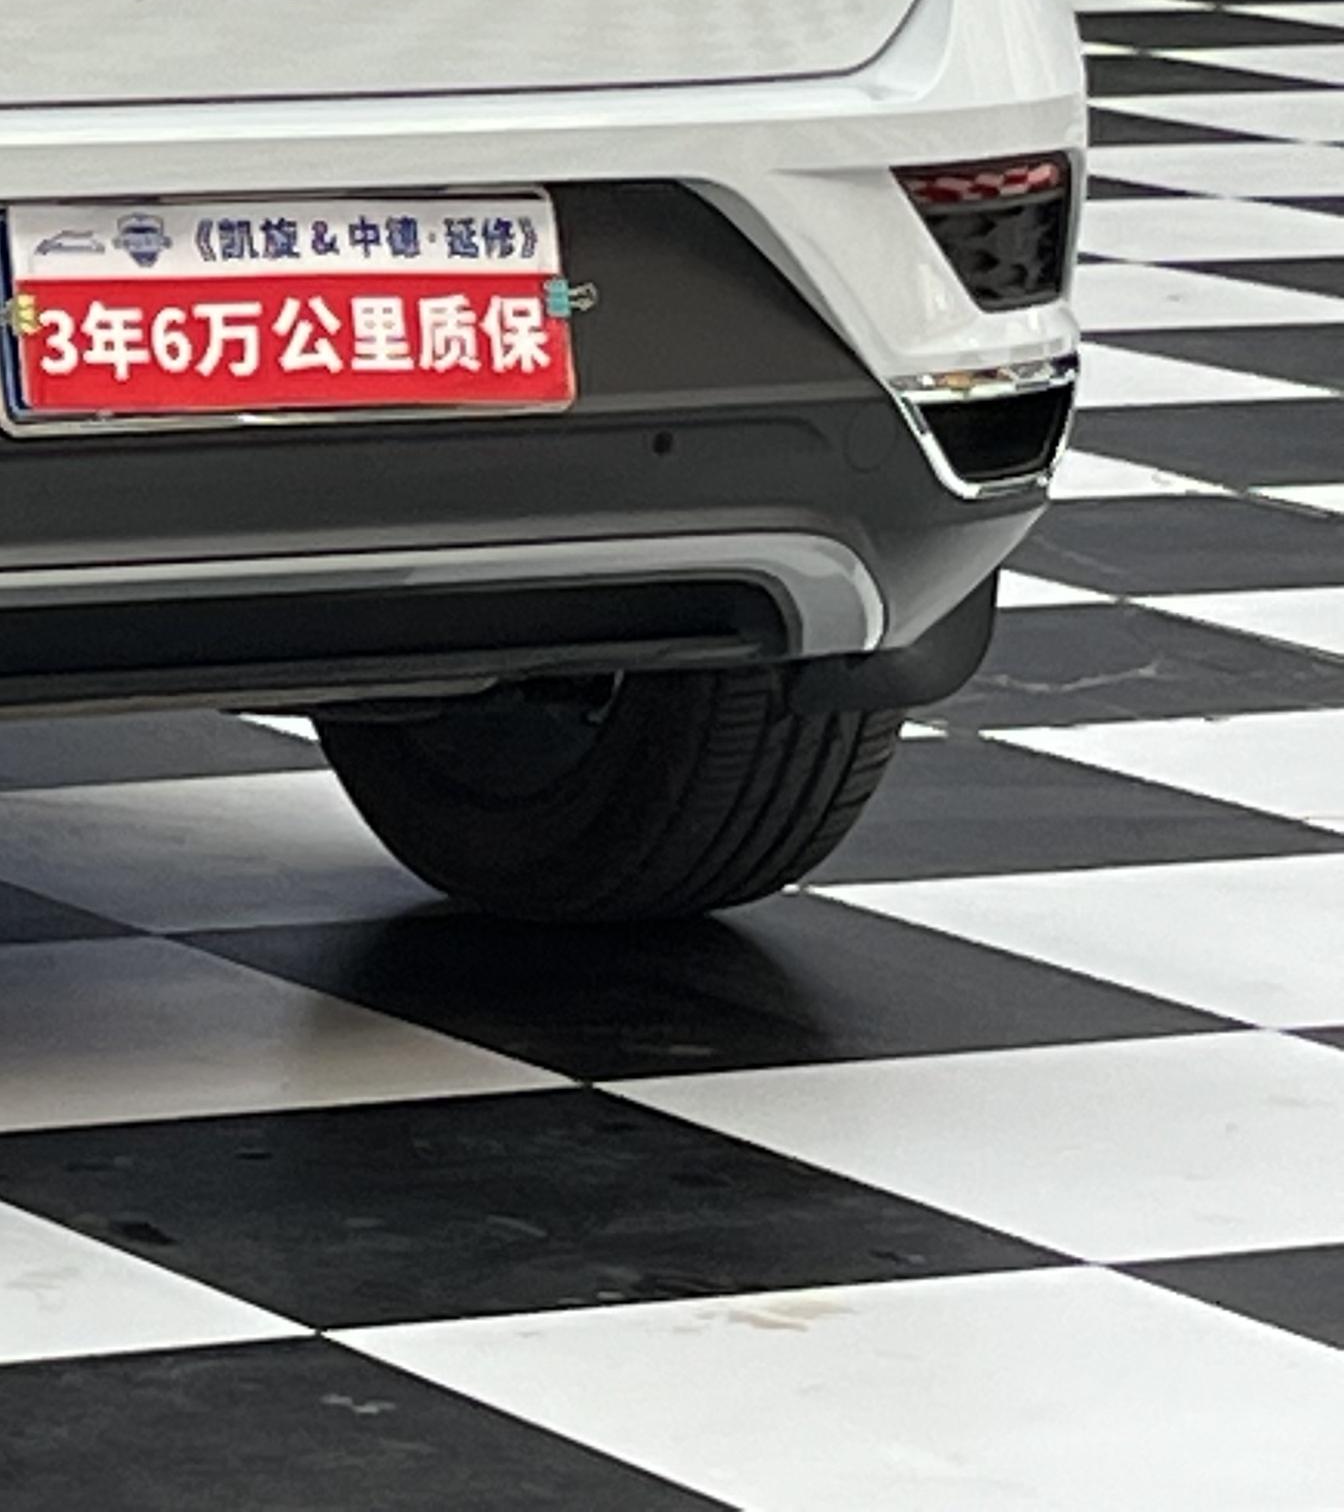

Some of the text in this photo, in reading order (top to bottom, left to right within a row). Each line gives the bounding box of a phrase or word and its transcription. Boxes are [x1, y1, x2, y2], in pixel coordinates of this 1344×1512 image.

[38, 293, 552, 381] 3年6万公里质保
